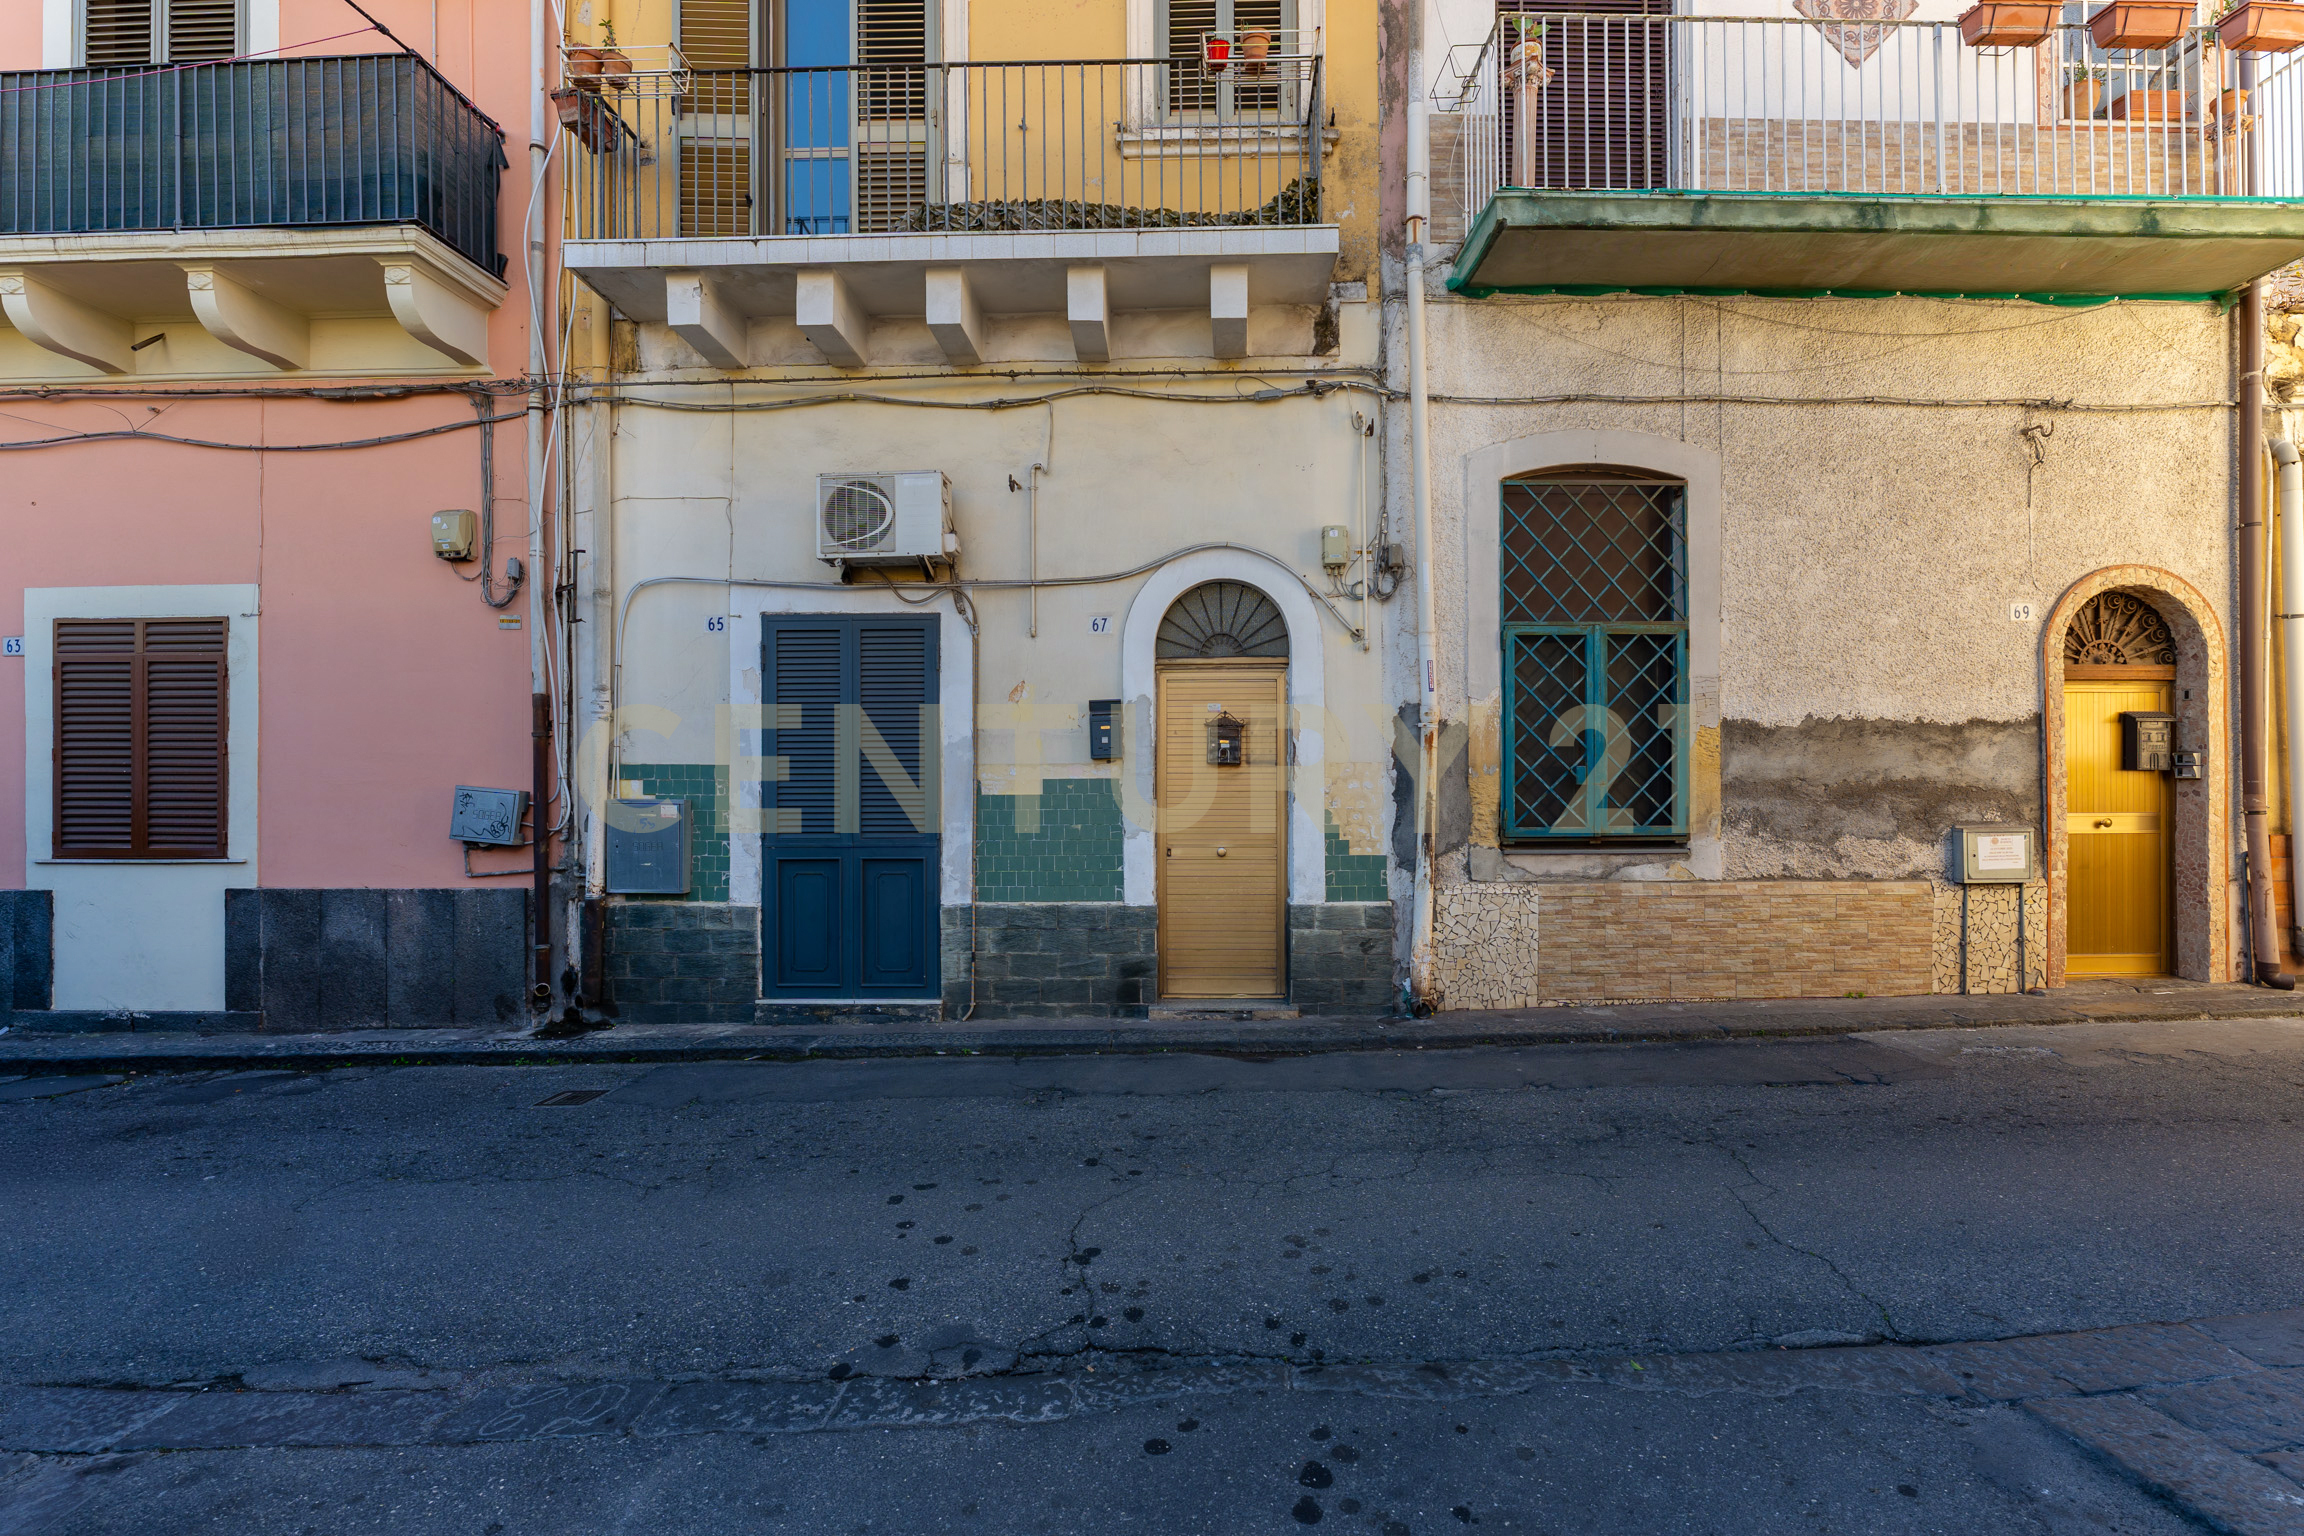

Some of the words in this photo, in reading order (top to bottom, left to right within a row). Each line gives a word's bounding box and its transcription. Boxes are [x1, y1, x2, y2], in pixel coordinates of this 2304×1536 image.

[2014, 605, 2029, 619] 69
[708, 616, 724, 631] 65
[1092, 617, 1108, 632] 67
[7, 639, 21, 653] 63
[632, 841, 664, 852] SOGEA
